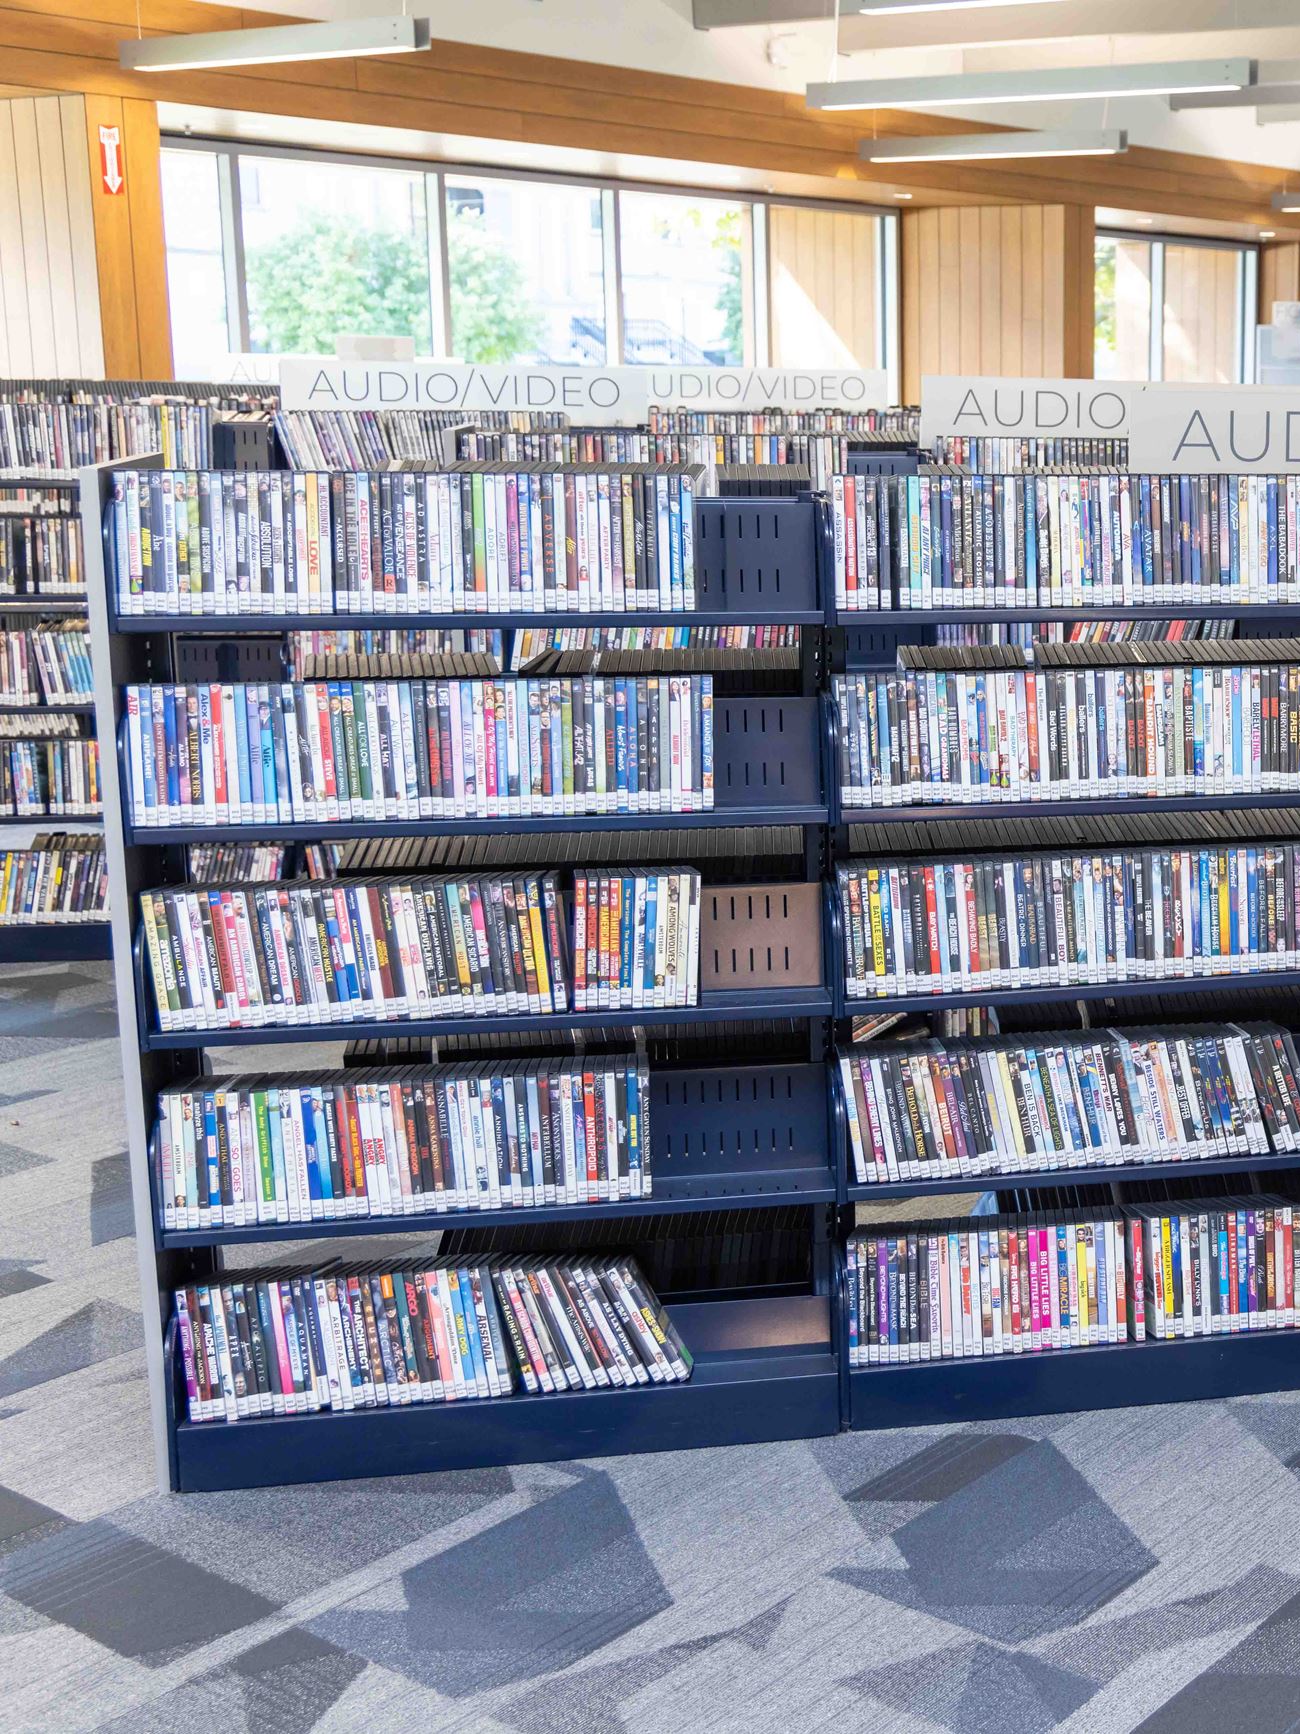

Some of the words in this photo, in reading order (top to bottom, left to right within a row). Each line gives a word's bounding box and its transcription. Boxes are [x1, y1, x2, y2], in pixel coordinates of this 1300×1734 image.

[308, 369, 620, 409] AUDIO/VIDEO
[648, 371, 866, 402] UDIO/VIDEO
[953, 388, 1128, 430] AUDIO
[344, 477, 354, 494] ACE
[346, 510, 356, 529] THE
[405, 511, 416, 530] ACTS
[1278, 504, 1286, 522] THE
[141, 527, 152, 567] ABDUCTION
[261, 521, 272, 568] ABSOLUTION
[309, 540, 318, 575] LOVE
[336, 523, 344, 562] ACCURSED
[347, 531, 357, 554] HOLE
[395, 521, 405, 579] VENGEANCE
[418, 525, 427, 562] ASTRA
[498, 531, 507, 562] ADRIFT
[544, 514, 554, 573] ADVERSE
[1278, 524, 1287, 574] BABADOOK
[407, 543, 417, 578] VIOLENCE
[127, 694, 138, 716] AIR
[1078, 705, 1086, 733] ballers
[1146, 699, 1155, 737] BANDIT
[939, 714, 949, 734] BAD
[1049, 726, 1058, 751] Words
[1185, 705, 1193, 741] BAPTISTE
[1280, 702, 1288, 753] BARRYMORE
[189, 729, 200, 764] ALBERT
[629, 726, 637, 768] ALOHA
[940, 737, 949, 779] GRANDMAS
[1148, 739, 1156, 774] HOUND
[191, 768, 201, 799] NOBBS
[667, 906, 676, 932] AMONG
[873, 905, 882, 932] BATTLE
[1055, 896, 1065, 942] BEAUTIFUL
[1144, 899, 1152, 910] THE
[930, 911, 939, 951] BAYWATCH
[1144, 910, 1153, 935] BEAVER
[146, 919, 158, 967] AMAZING
[154, 973, 167, 1009] GRACE
[160, 940, 176, 990] amazonia
[172, 935, 186, 988] AMBULANCE
[261, 923, 274, 958] AMERICAN
[268, 960, 278, 985] DREAM
[318, 923, 330, 957] AMERICAN
[324, 958, 334, 982] HUSTLE
[668, 933, 677, 962] WOLVES
[875, 941, 884, 966] SEXES
[1058, 944, 1066, 963] BOY
[1023, 1083, 1034, 1099] BEN
[1040, 1066, 1052, 1096] BENEATH
[1047, 1102, 1056, 1115] SEA
[1053, 1127, 1062, 1150] LIGHTS
[1104, 1095, 1112, 1112] WAR
[194, 1102, 202, 1126] analyze
[938, 1102, 952, 1136] BEIRUT
[1028, 1113, 1040, 1138] BACK
[196, 1127, 204, 1140] this
[293, 1120, 303, 1145] ANGEL
[586, 1116, 597, 1171] ANTHROPOID
[174, 1144, 182, 1175] AMSTERDAM
[296, 1146, 304, 1162] HAS
[298, 1165, 307, 1200] FALLEN
[1040, 1251, 1048, 1266] BIG
[405, 1281, 418, 1316] ARGO
[919, 1280, 928, 1309] BIBLE
[1040, 1268, 1048, 1294] LITTLE
[1059, 1276, 1069, 1314] MIRACLE
[909, 1312, 918, 1329] SEA
[203, 1323, 215, 1354] APACHE
[230, 1335, 239, 1358] APEX
[298, 1322, 309, 1375] AQUAMAN
[332, 1316, 346, 1371] ARBITRAGE
[343, 1315, 357, 1371] ARCHENEMY
[353, 1313, 369, 1370] ARCHITECT
[476, 1315, 492, 1362] ARSENAL
